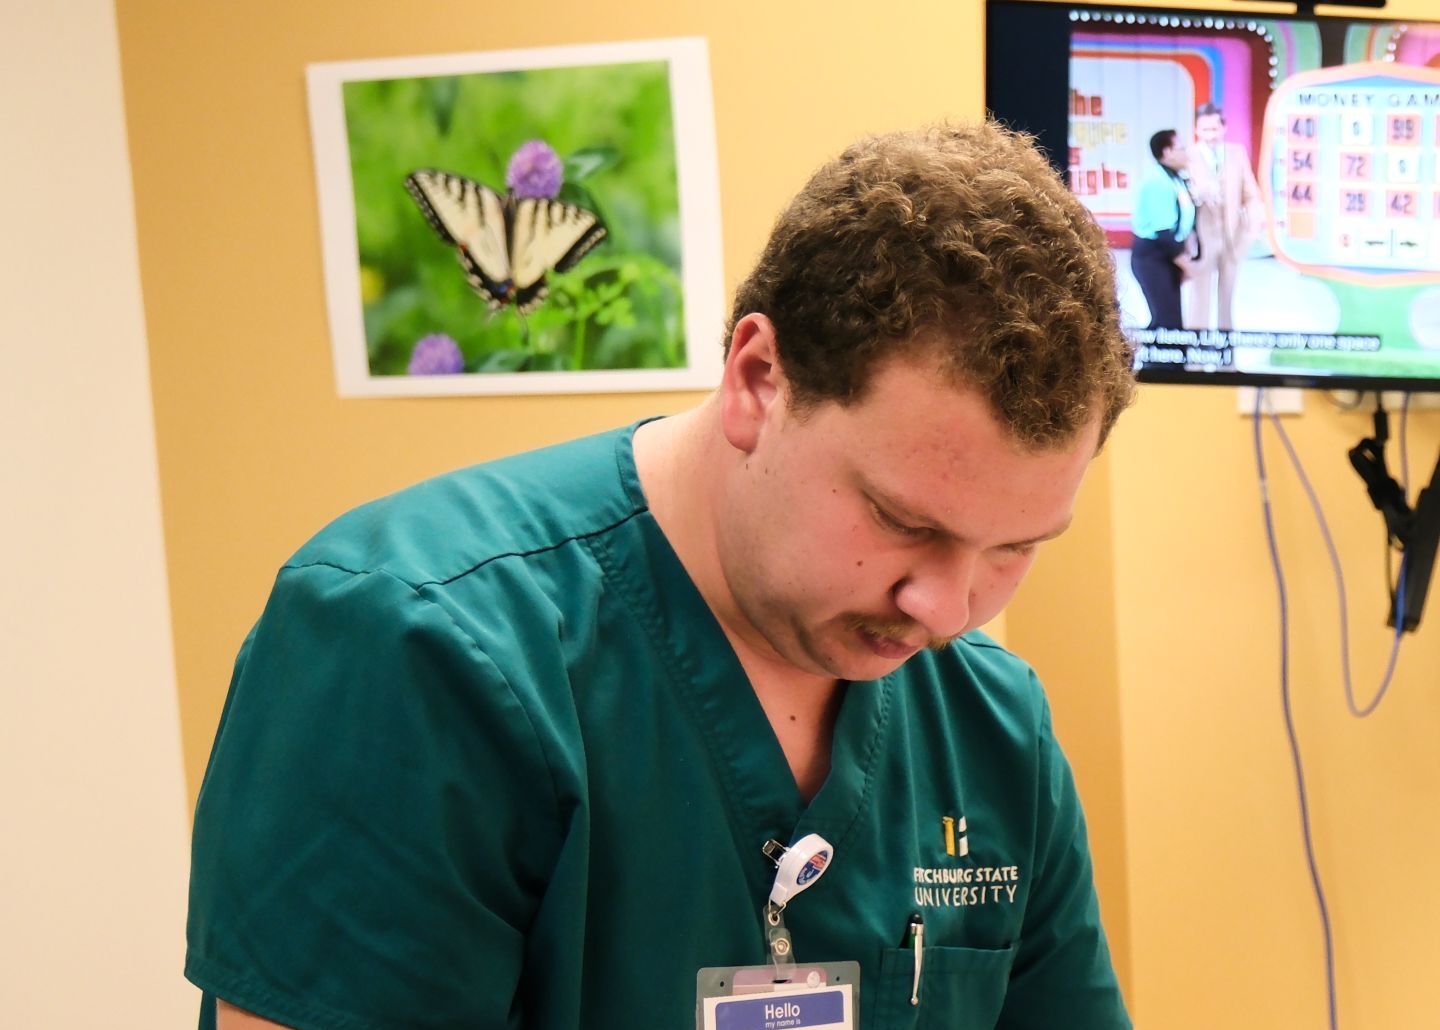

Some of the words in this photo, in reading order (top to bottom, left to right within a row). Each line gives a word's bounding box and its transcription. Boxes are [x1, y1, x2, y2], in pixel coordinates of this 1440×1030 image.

[1070, 87, 1102, 117] he
[1298, 93, 1375, 108] MONEY
[1346, 154, 1367, 178] 72
[975, 866, 1019, 882] STATE
[914, 884, 1017, 907] UNIVERSITY
[765, 1002, 801, 1020] Hello
[765, 1021, 775, 1029] my
